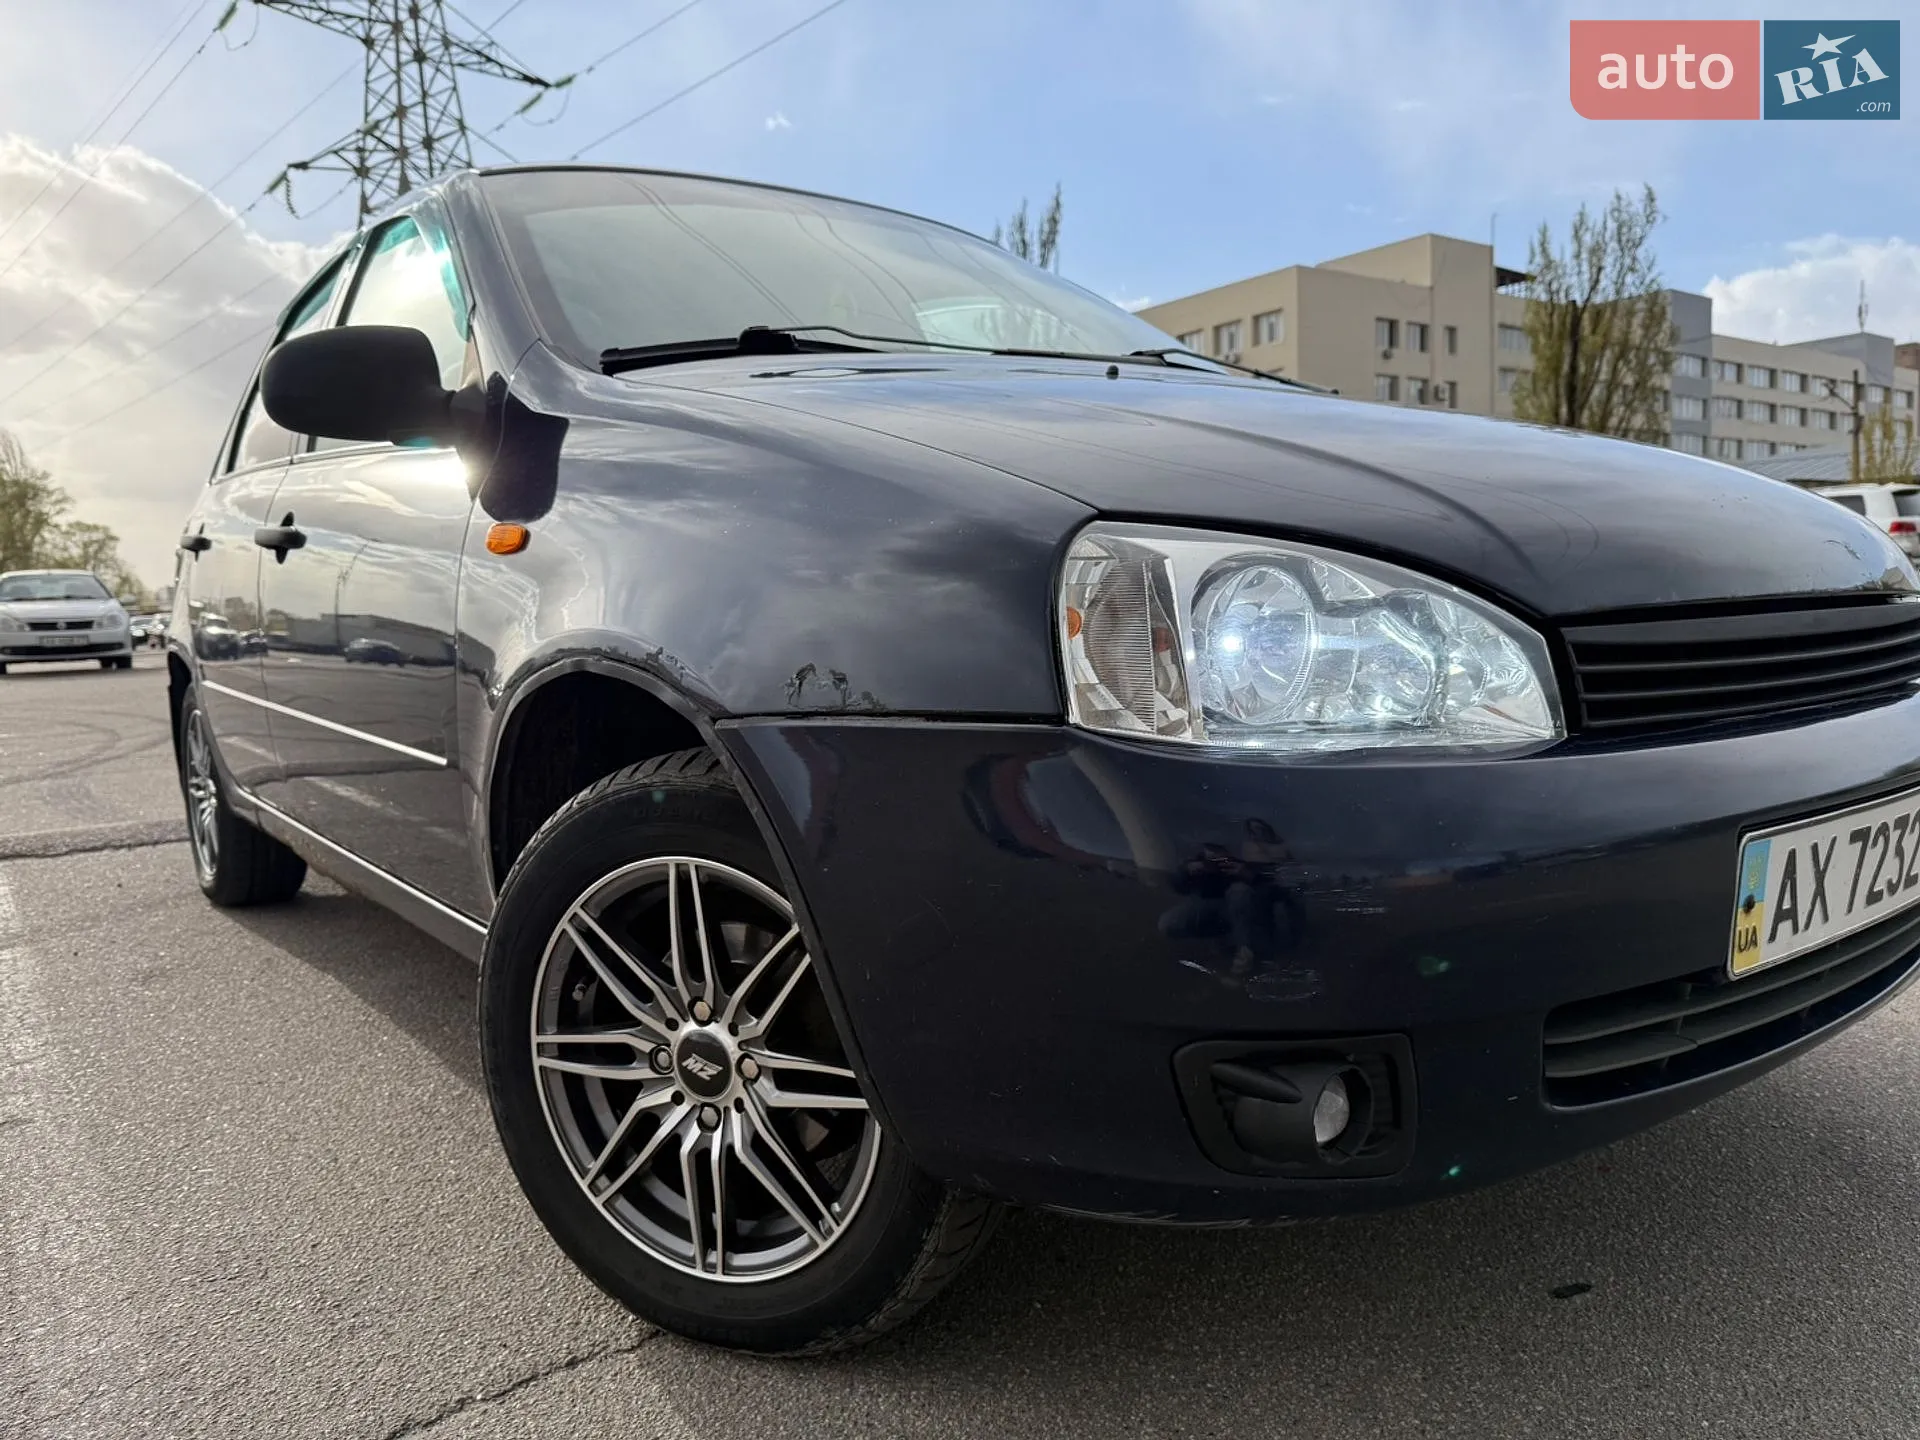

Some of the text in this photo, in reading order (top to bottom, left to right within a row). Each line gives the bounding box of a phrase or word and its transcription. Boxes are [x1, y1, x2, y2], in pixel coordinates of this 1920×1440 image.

[1767, 807, 1920, 944] AX 7232
[1737, 925, 1759, 953] UA
